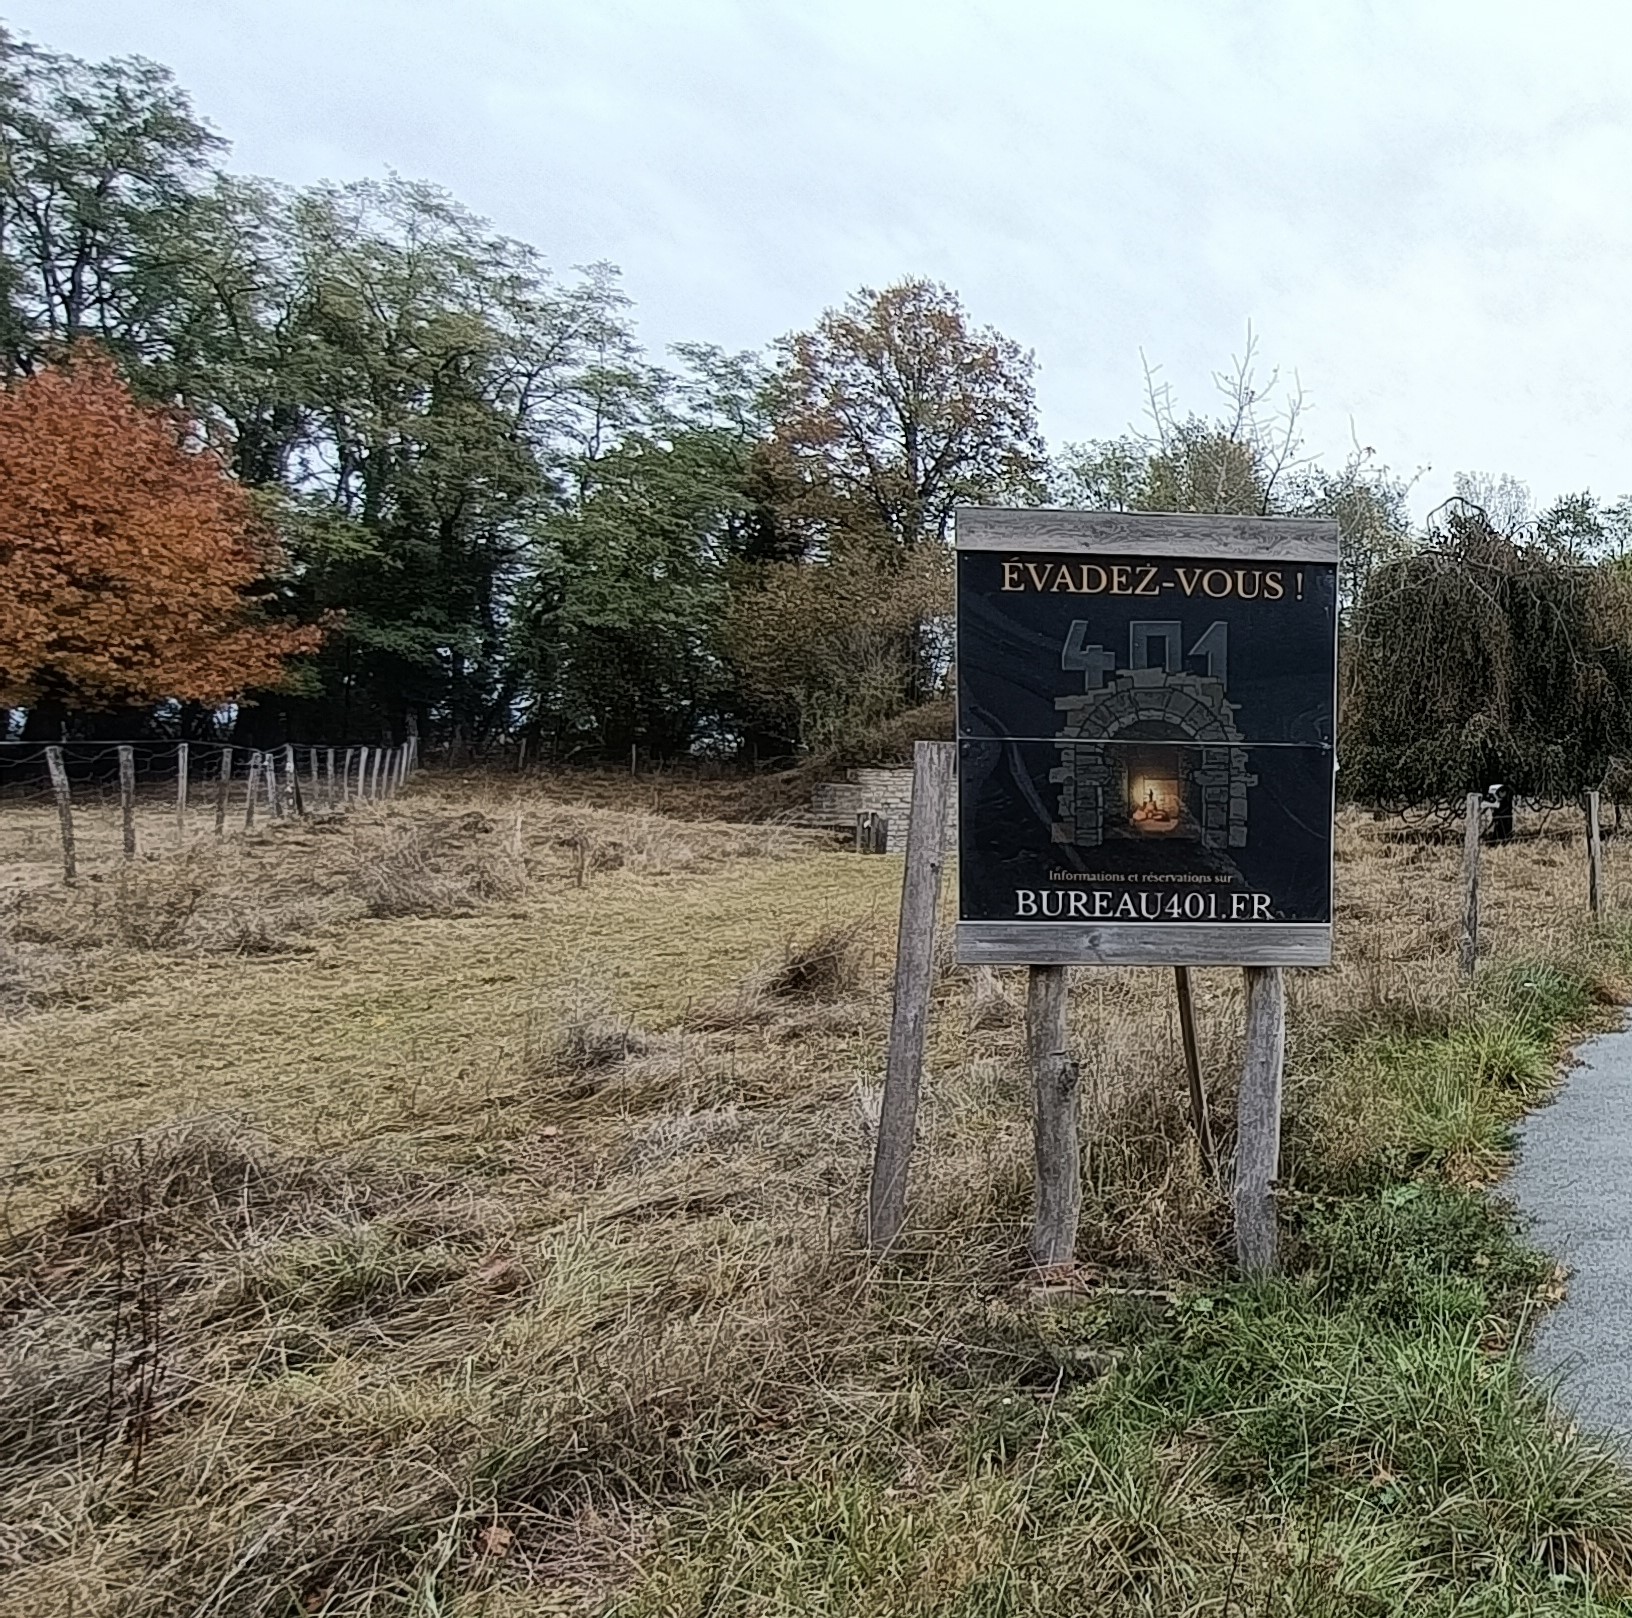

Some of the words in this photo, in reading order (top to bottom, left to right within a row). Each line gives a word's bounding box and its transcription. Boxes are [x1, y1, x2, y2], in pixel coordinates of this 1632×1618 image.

[1001, 557, 1284, 600] ÉVADEZ-VOUS
[1062, 619, 1228, 691] 401
[1049, 870, 1126, 883] Informations
[1128, 872, 1139, 883] et
[1142, 871, 1212, 885] réservations
[1215, 874, 1234, 884] sur
[1015, 889, 1275, 920] BUREAU401.FR
